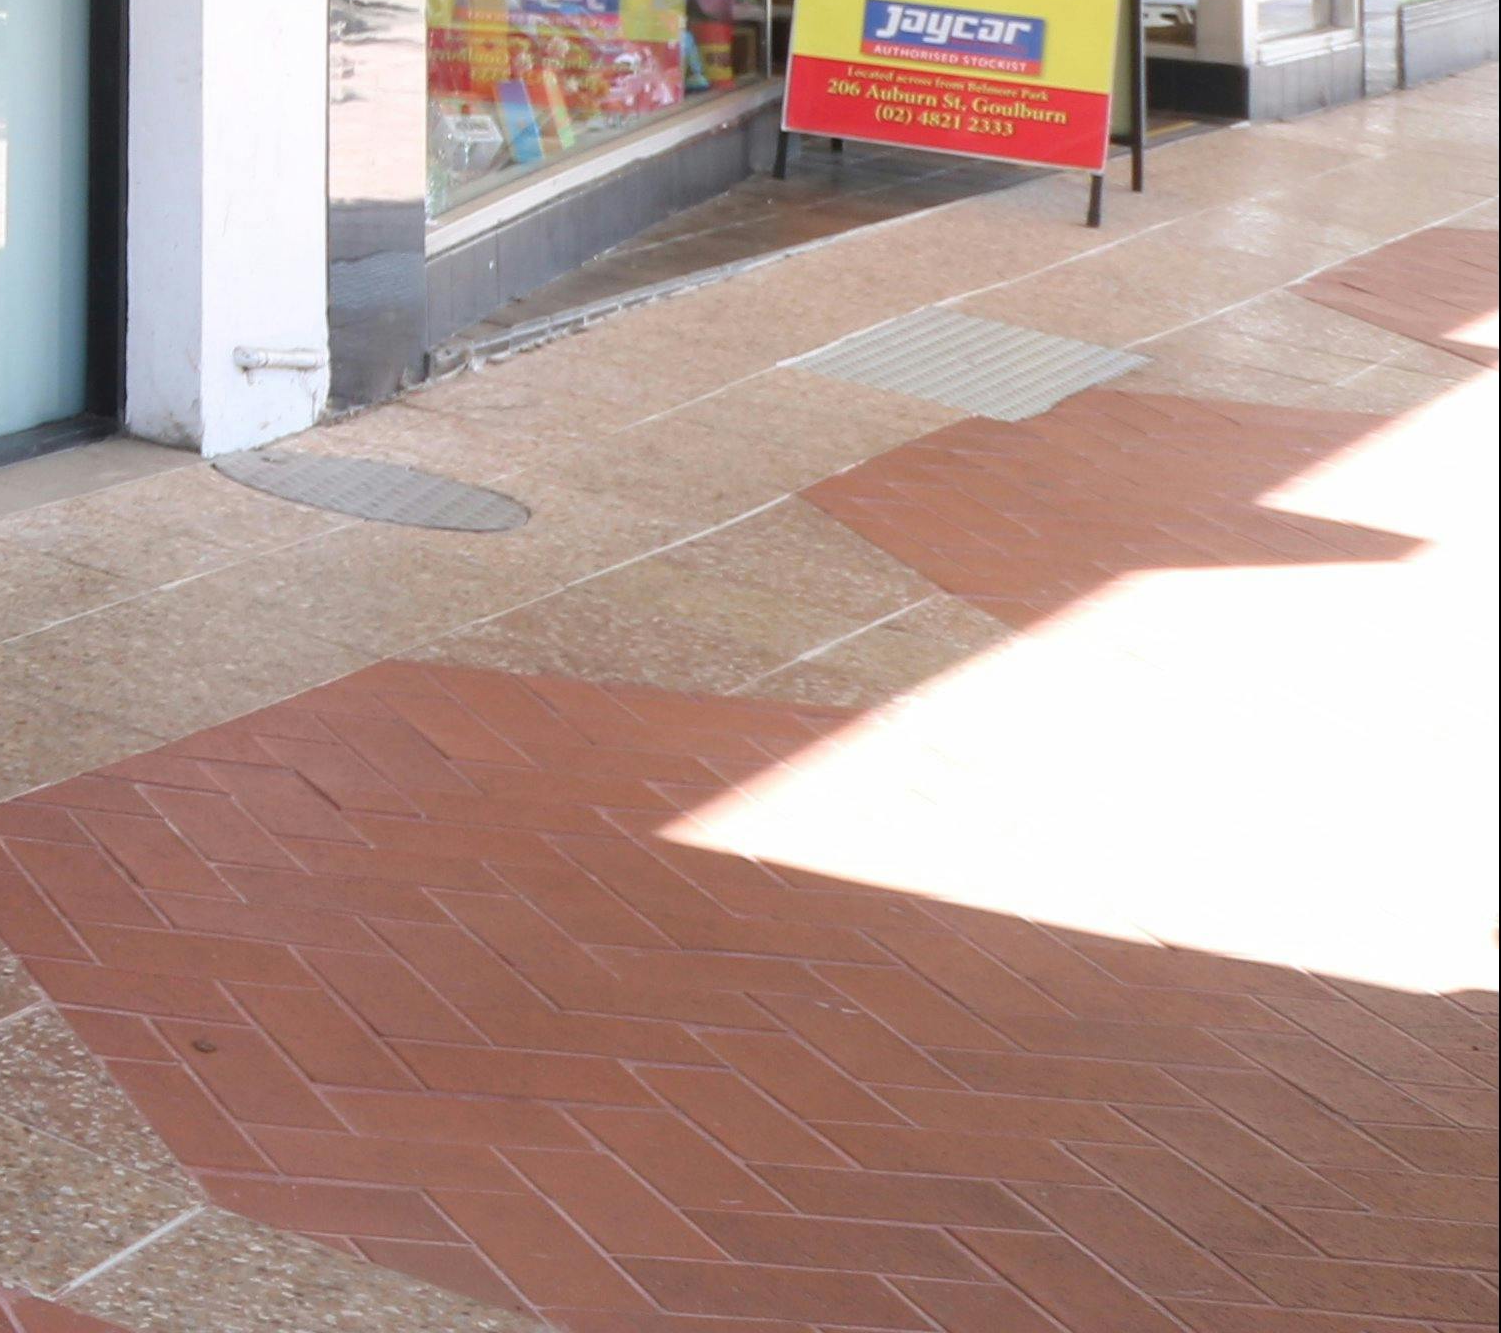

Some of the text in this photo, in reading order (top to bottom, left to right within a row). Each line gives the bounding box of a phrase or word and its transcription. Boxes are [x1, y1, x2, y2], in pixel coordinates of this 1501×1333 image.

[874, 44, 958, 64] AUTHORISED
[962, 54, 1028, 73] STOCKIST
[827, 78, 1068, 124] 206 Auburn St. Goulburn
[847, 66, 1049, 102] Located across from Belmore Park
[875, 105, 1015, 137] (02) 4821 2333
